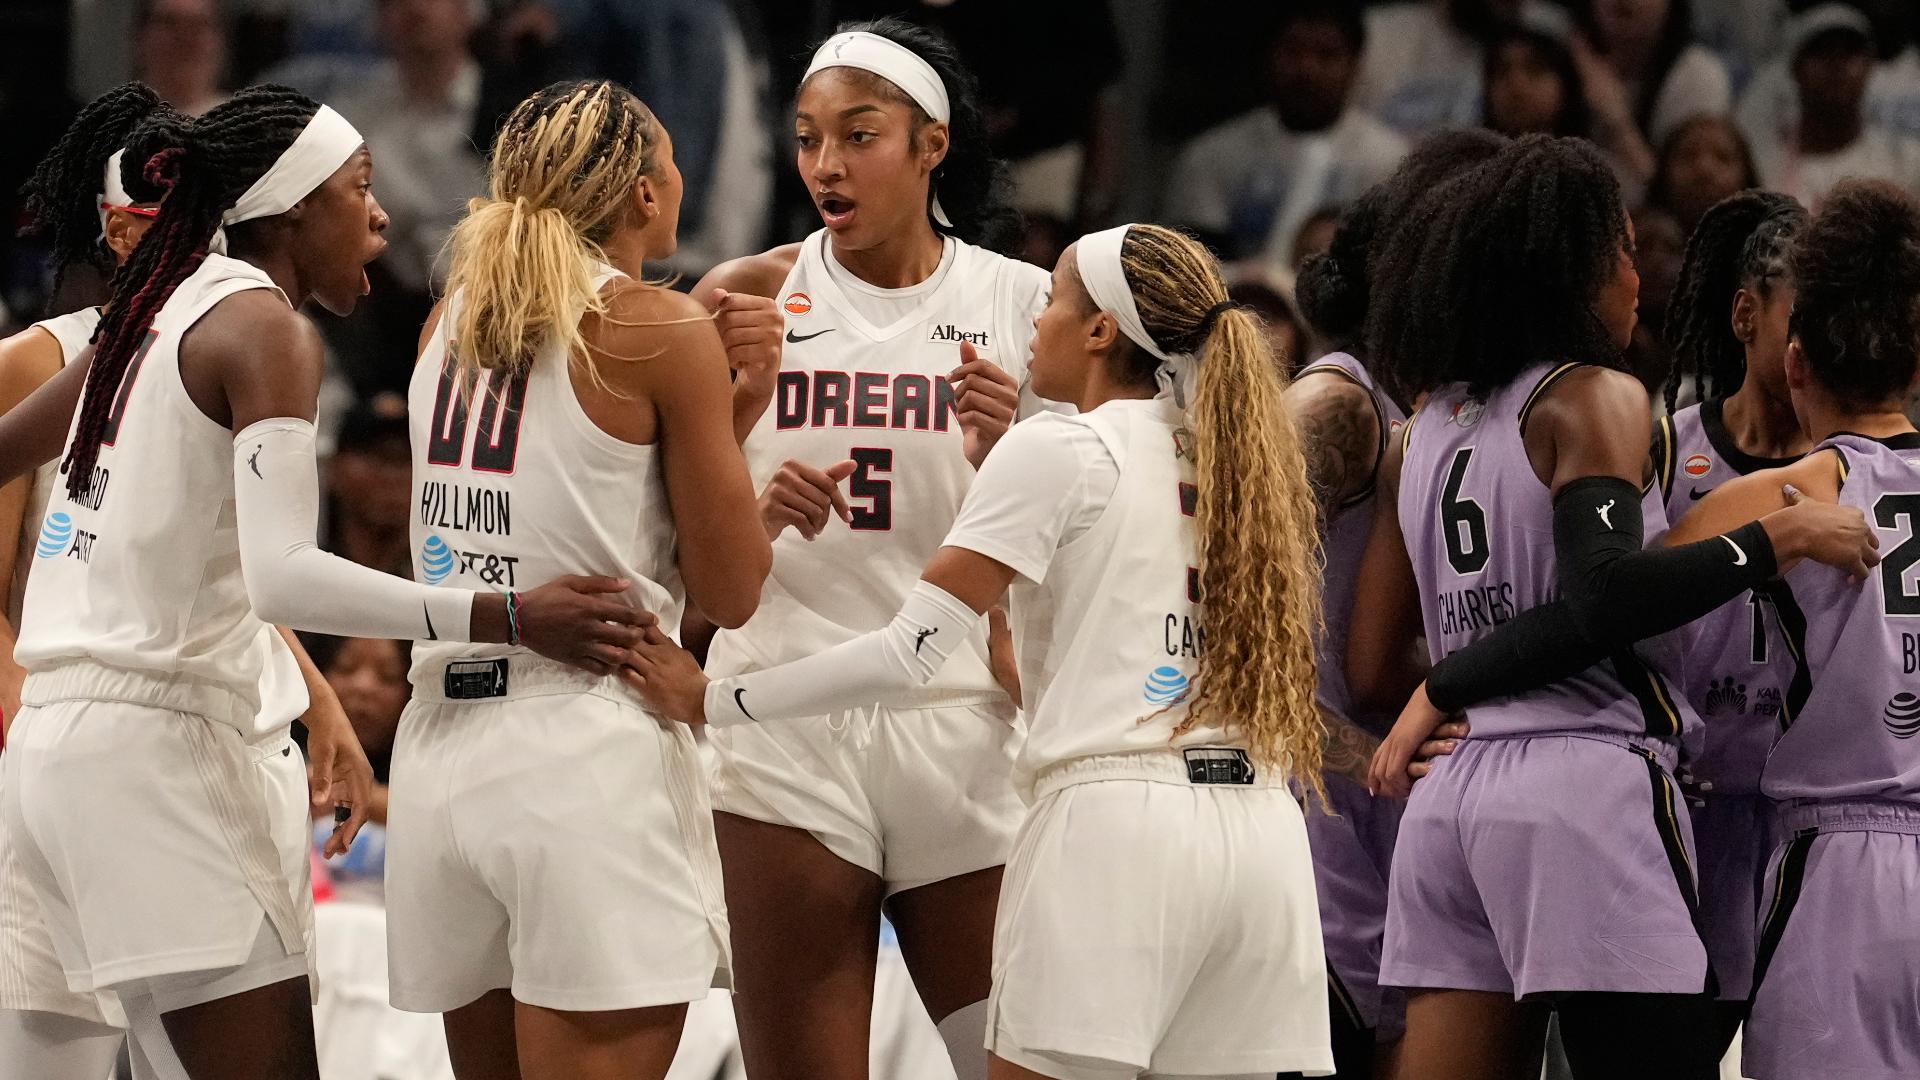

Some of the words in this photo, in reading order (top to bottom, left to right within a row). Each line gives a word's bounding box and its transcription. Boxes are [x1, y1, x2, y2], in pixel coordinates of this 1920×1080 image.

[931, 324, 989, 346] Albert
[421, 481, 511, 536] HILLMON
[849, 447, 894, 532] 5
[1440, 445, 1490, 577] 6
